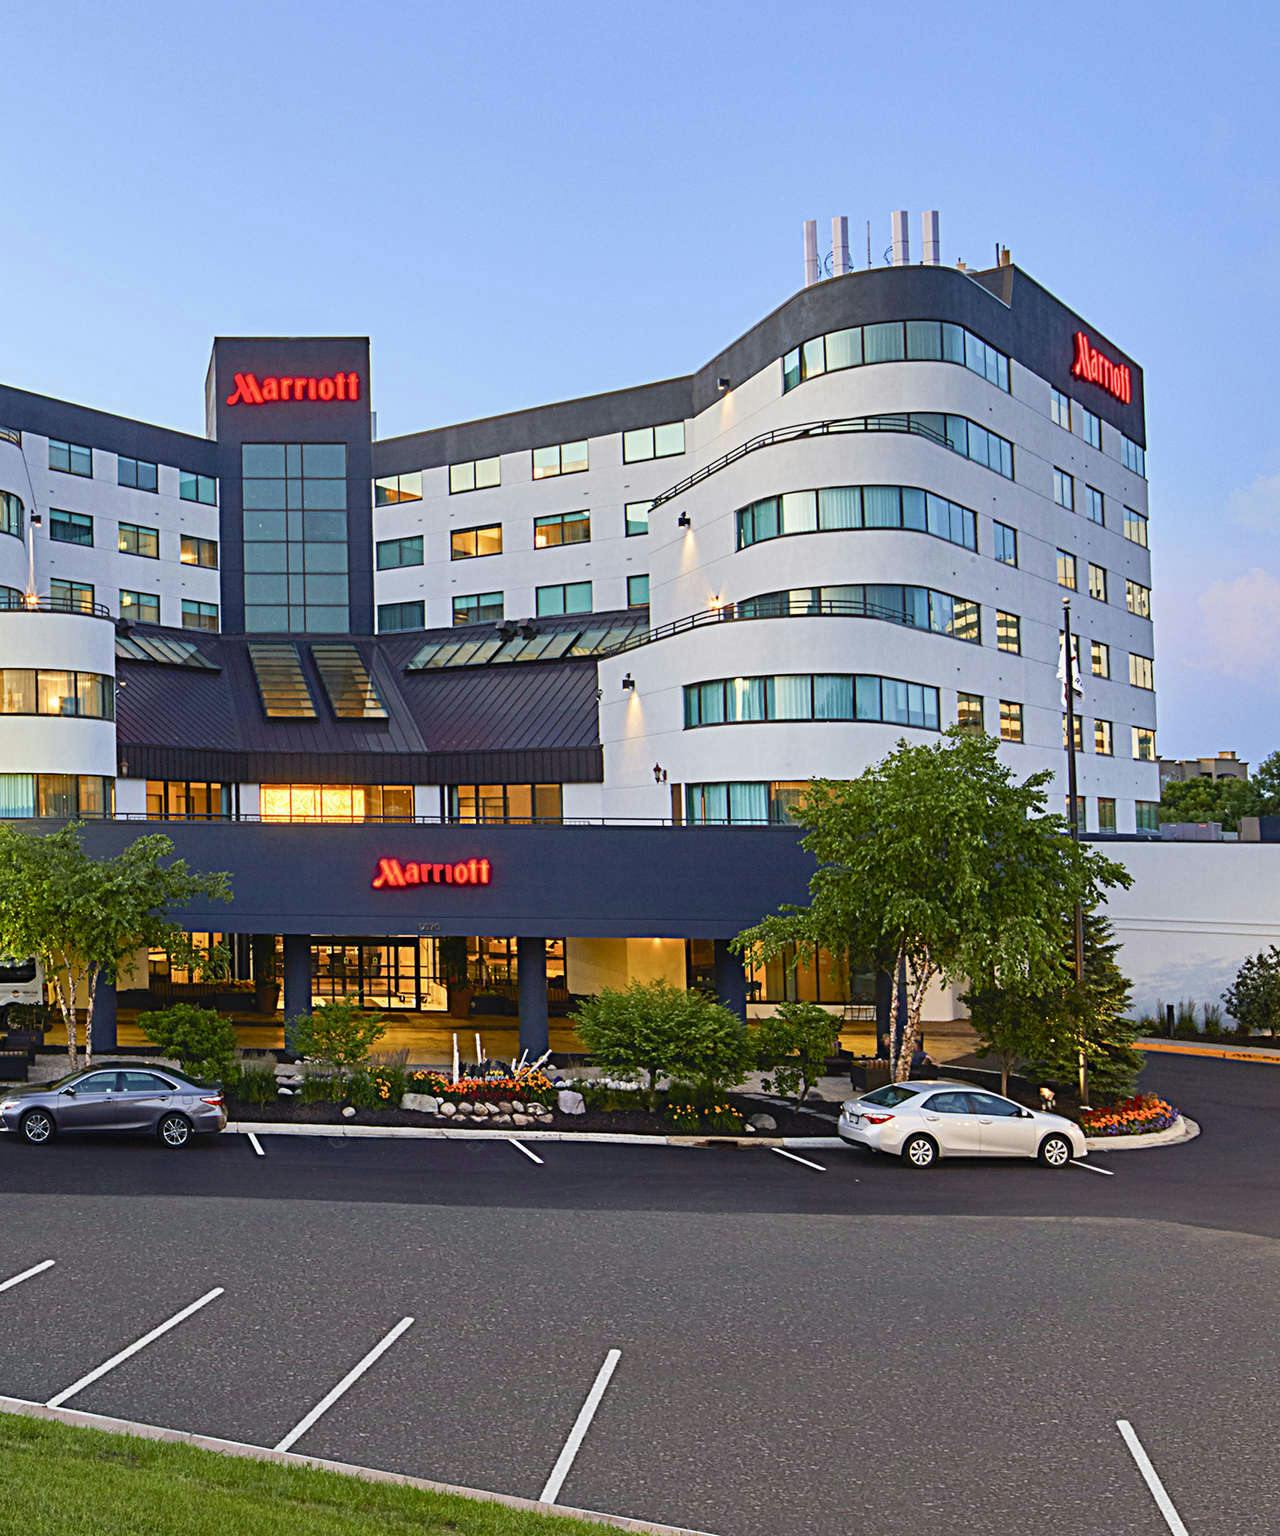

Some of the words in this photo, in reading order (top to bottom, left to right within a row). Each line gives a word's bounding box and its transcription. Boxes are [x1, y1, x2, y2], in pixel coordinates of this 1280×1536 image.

[1073, 331, 1131, 404] Marriott
[226, 372, 358, 405] Marriott
[372, 858, 489, 888] Marriott
